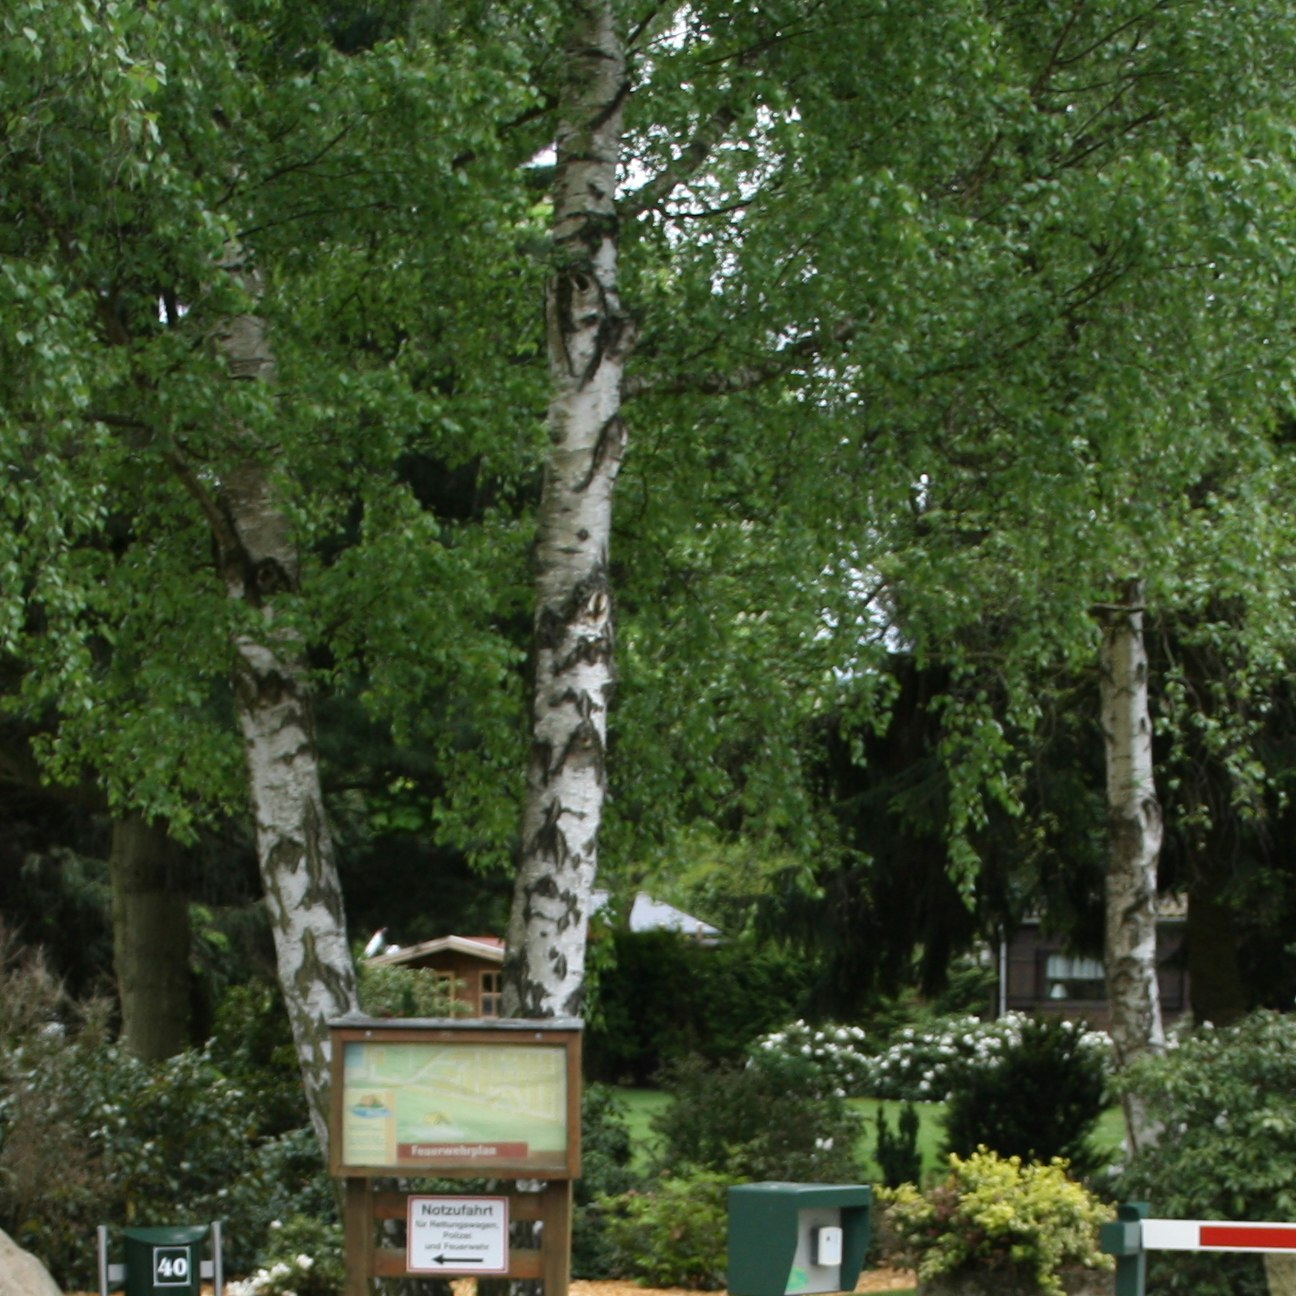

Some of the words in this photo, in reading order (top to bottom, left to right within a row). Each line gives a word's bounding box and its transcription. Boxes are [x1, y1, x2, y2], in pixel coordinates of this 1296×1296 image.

[411, 1145, 497, 1158] Feuerwehrplan
[422, 1204, 494, 1216] Notzufahrt
[415, 1220, 427, 1228] für
[430, 1220, 499, 1230] Rettungswagen,
[443, 1231, 472, 1239] Polizei
[425, 1242, 441, 1250] und
[444, 1242, 490, 1250] Feuerwehr
[157, 1257, 187, 1277] 40
